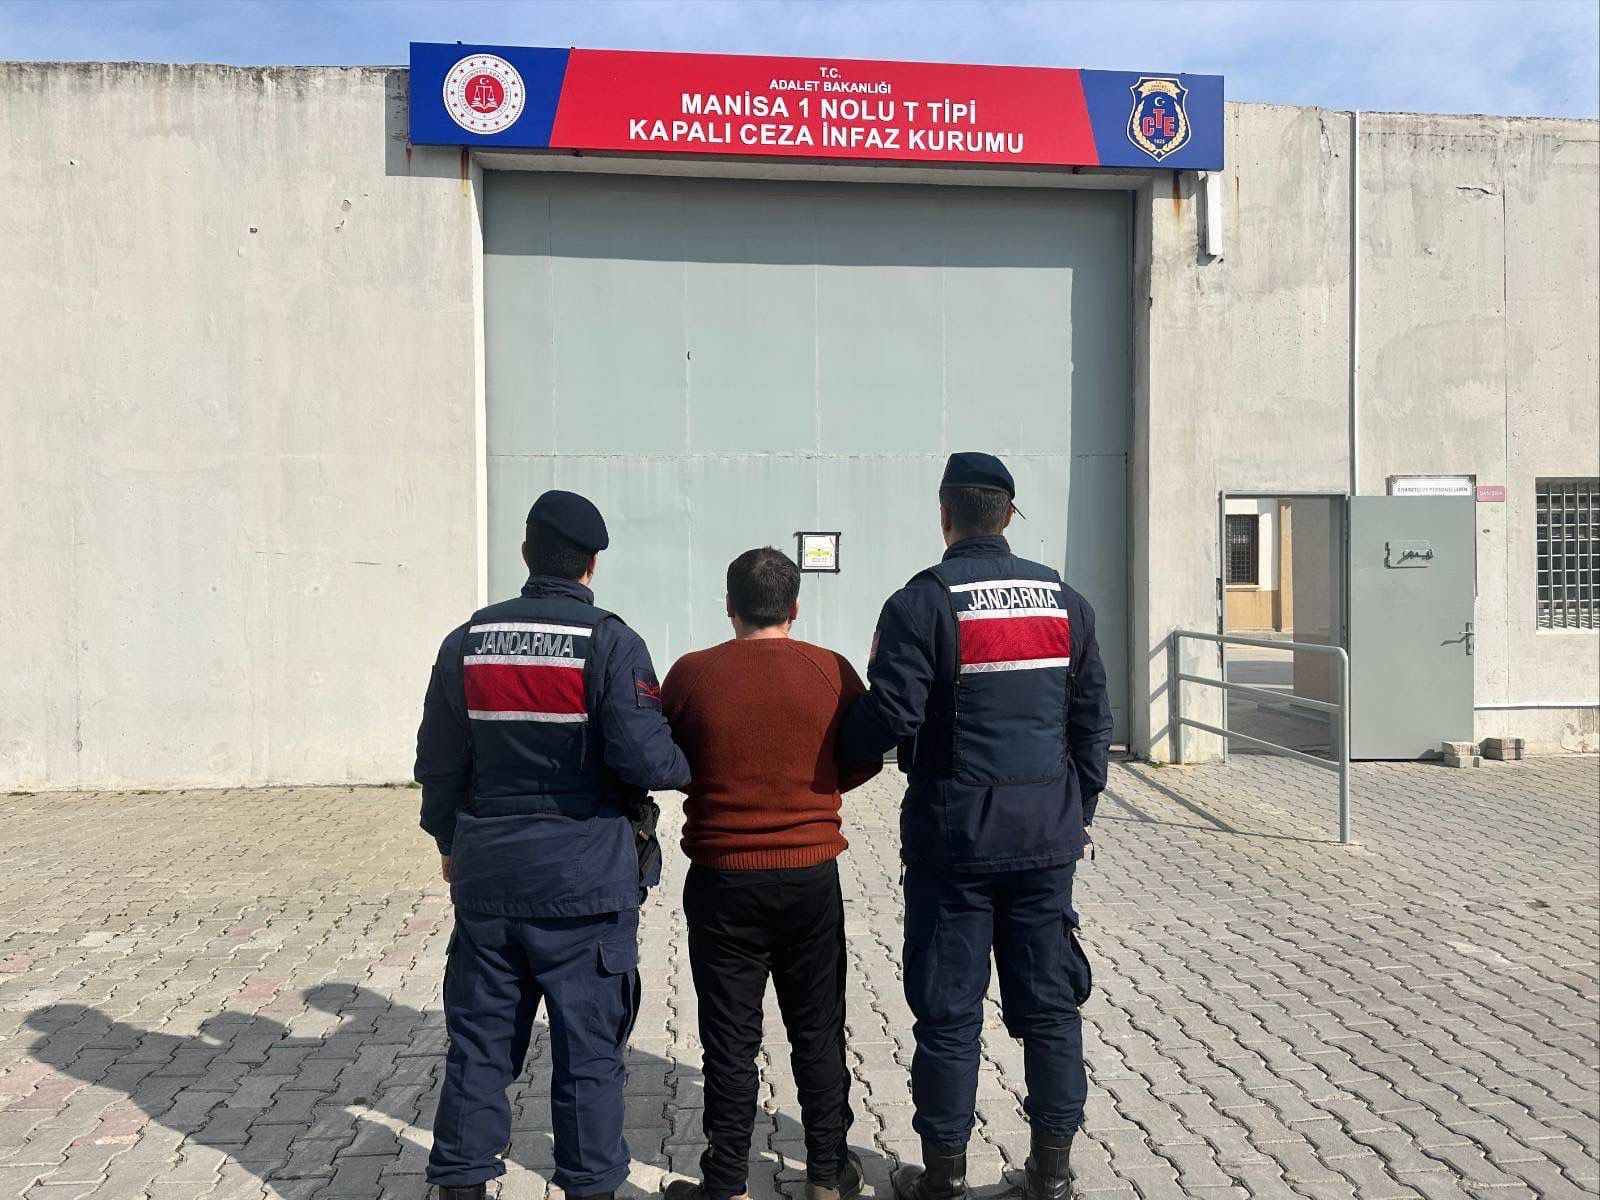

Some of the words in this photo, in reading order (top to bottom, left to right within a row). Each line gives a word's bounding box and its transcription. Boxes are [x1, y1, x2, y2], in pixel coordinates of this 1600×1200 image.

[820, 67, 841, 78] T.C.
[769, 79, 820, 92] ADALET
[823, 81, 891, 94] BAKANLIĞI
[681, 91, 789, 118] MANİSA
[798, 98, 809, 118] 1
[821, 98, 895, 122] NOLU
[903, 102, 919, 122] T
[927, 98, 976, 125] TİPİ
[1142, 108, 1175, 137] CTE
[629, 119, 731, 144] KAPALI
[739, 123, 814, 147] CEZA
[823, 121, 900, 149] İNFAZ
[908, 128, 1024, 153] KURUMU
[967, 587, 1059, 610] JANDARMA
[475, 632, 574, 657] JANDARMA
